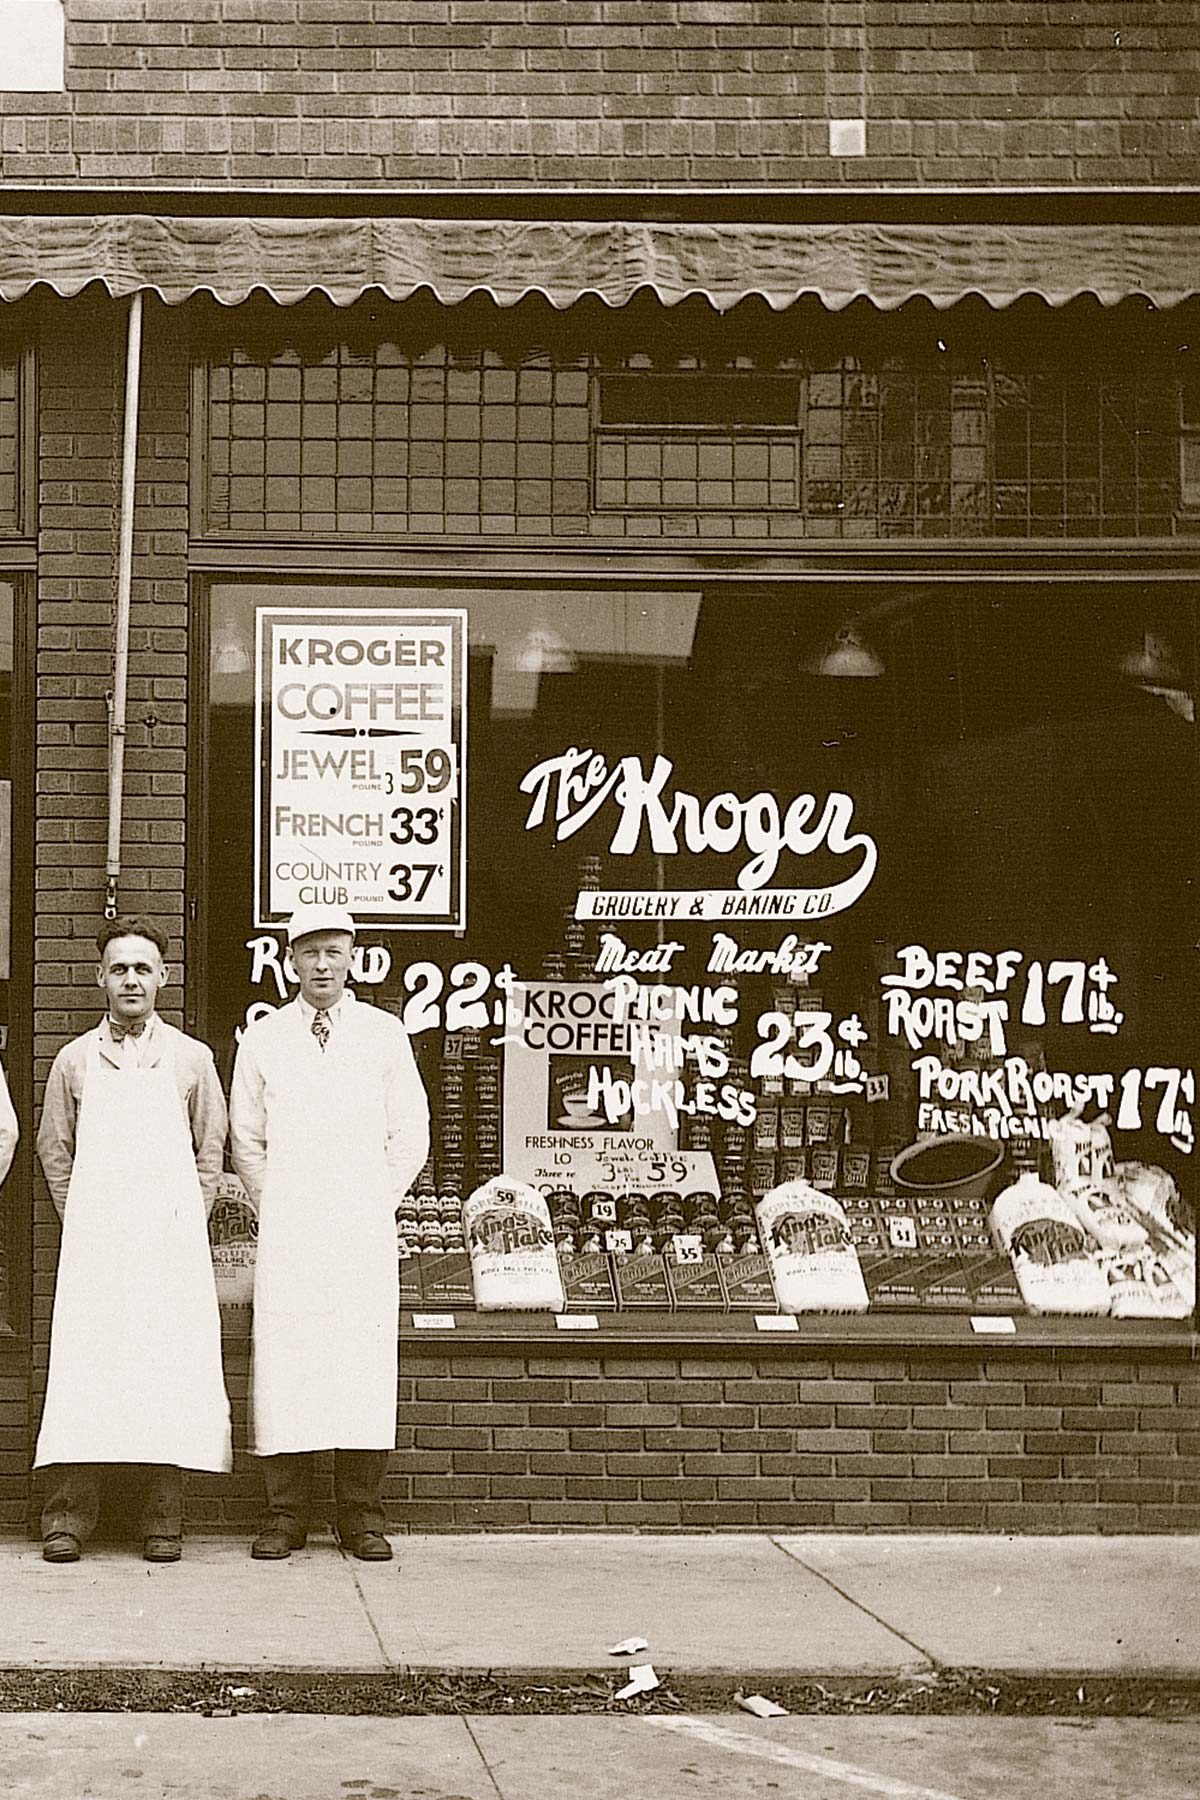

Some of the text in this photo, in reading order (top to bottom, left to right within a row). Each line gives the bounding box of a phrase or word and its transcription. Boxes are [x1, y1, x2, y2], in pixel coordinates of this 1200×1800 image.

[279, 638, 446, 667] KROGER
[276, 683, 445, 721] COFFEE
[276, 749, 382, 780] JEWEL
[385, 748, 452, 795] 3 59
[275, 806, 383, 837] FRENCH
[519, 747, 878, 890] The Kroger
[275, 863, 383, 881] COUNTRY
[299, 887, 349, 905] CLUB
[592, 894, 836, 917] GROCERY & BAKING CO.
[594, 933, 832, 974] Meat Market
[880, 945, 1023, 992] BEEF
[603, 975, 738, 1026] PICNIC
[881, 988, 1008, 1056] ROAST
[445, 1040, 460, 1054] 37
[587, 1065, 757, 1128] HOCKLESS
[911, 1056, 1013, 1116] PORK
[1004, 1056, 1115, 1116] ROAST
[525, 1136, 654, 1151] FRESHNESS FLAVOR
[601, 1163, 616, 1182] 3
[497, 1190, 515, 1204] 59
[596, 1204, 612, 1217] 19
[679, 1247, 698, 1260] 35
